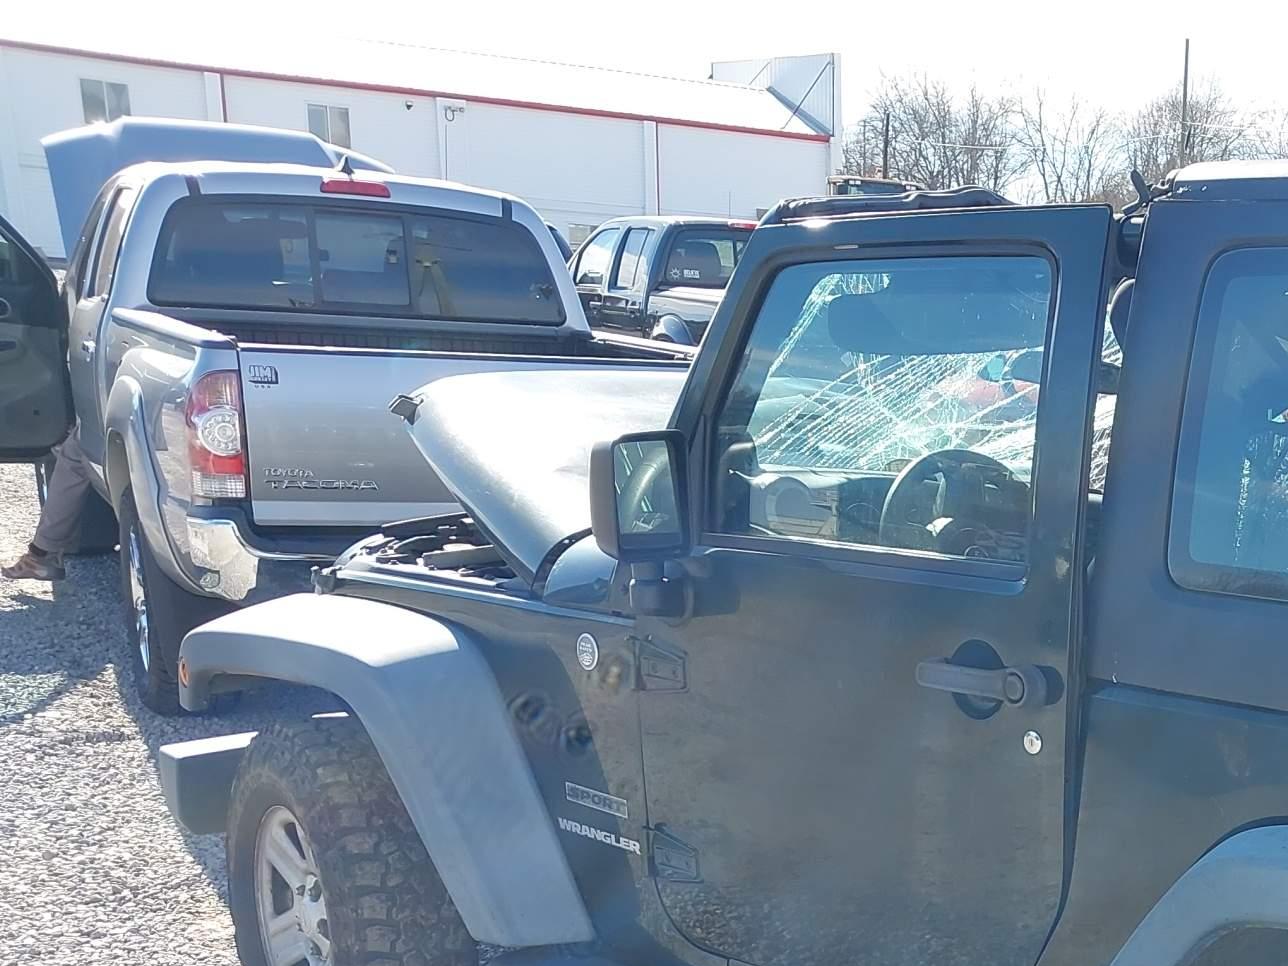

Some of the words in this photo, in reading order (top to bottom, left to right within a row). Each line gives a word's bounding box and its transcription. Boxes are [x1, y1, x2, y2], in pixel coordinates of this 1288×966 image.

[264, 467, 314, 478] TOYOTA
[264, 479, 379, 490] TACOMA
[567, 785, 627, 815] SPORT
[558, 817, 641, 855] WRANGLER
